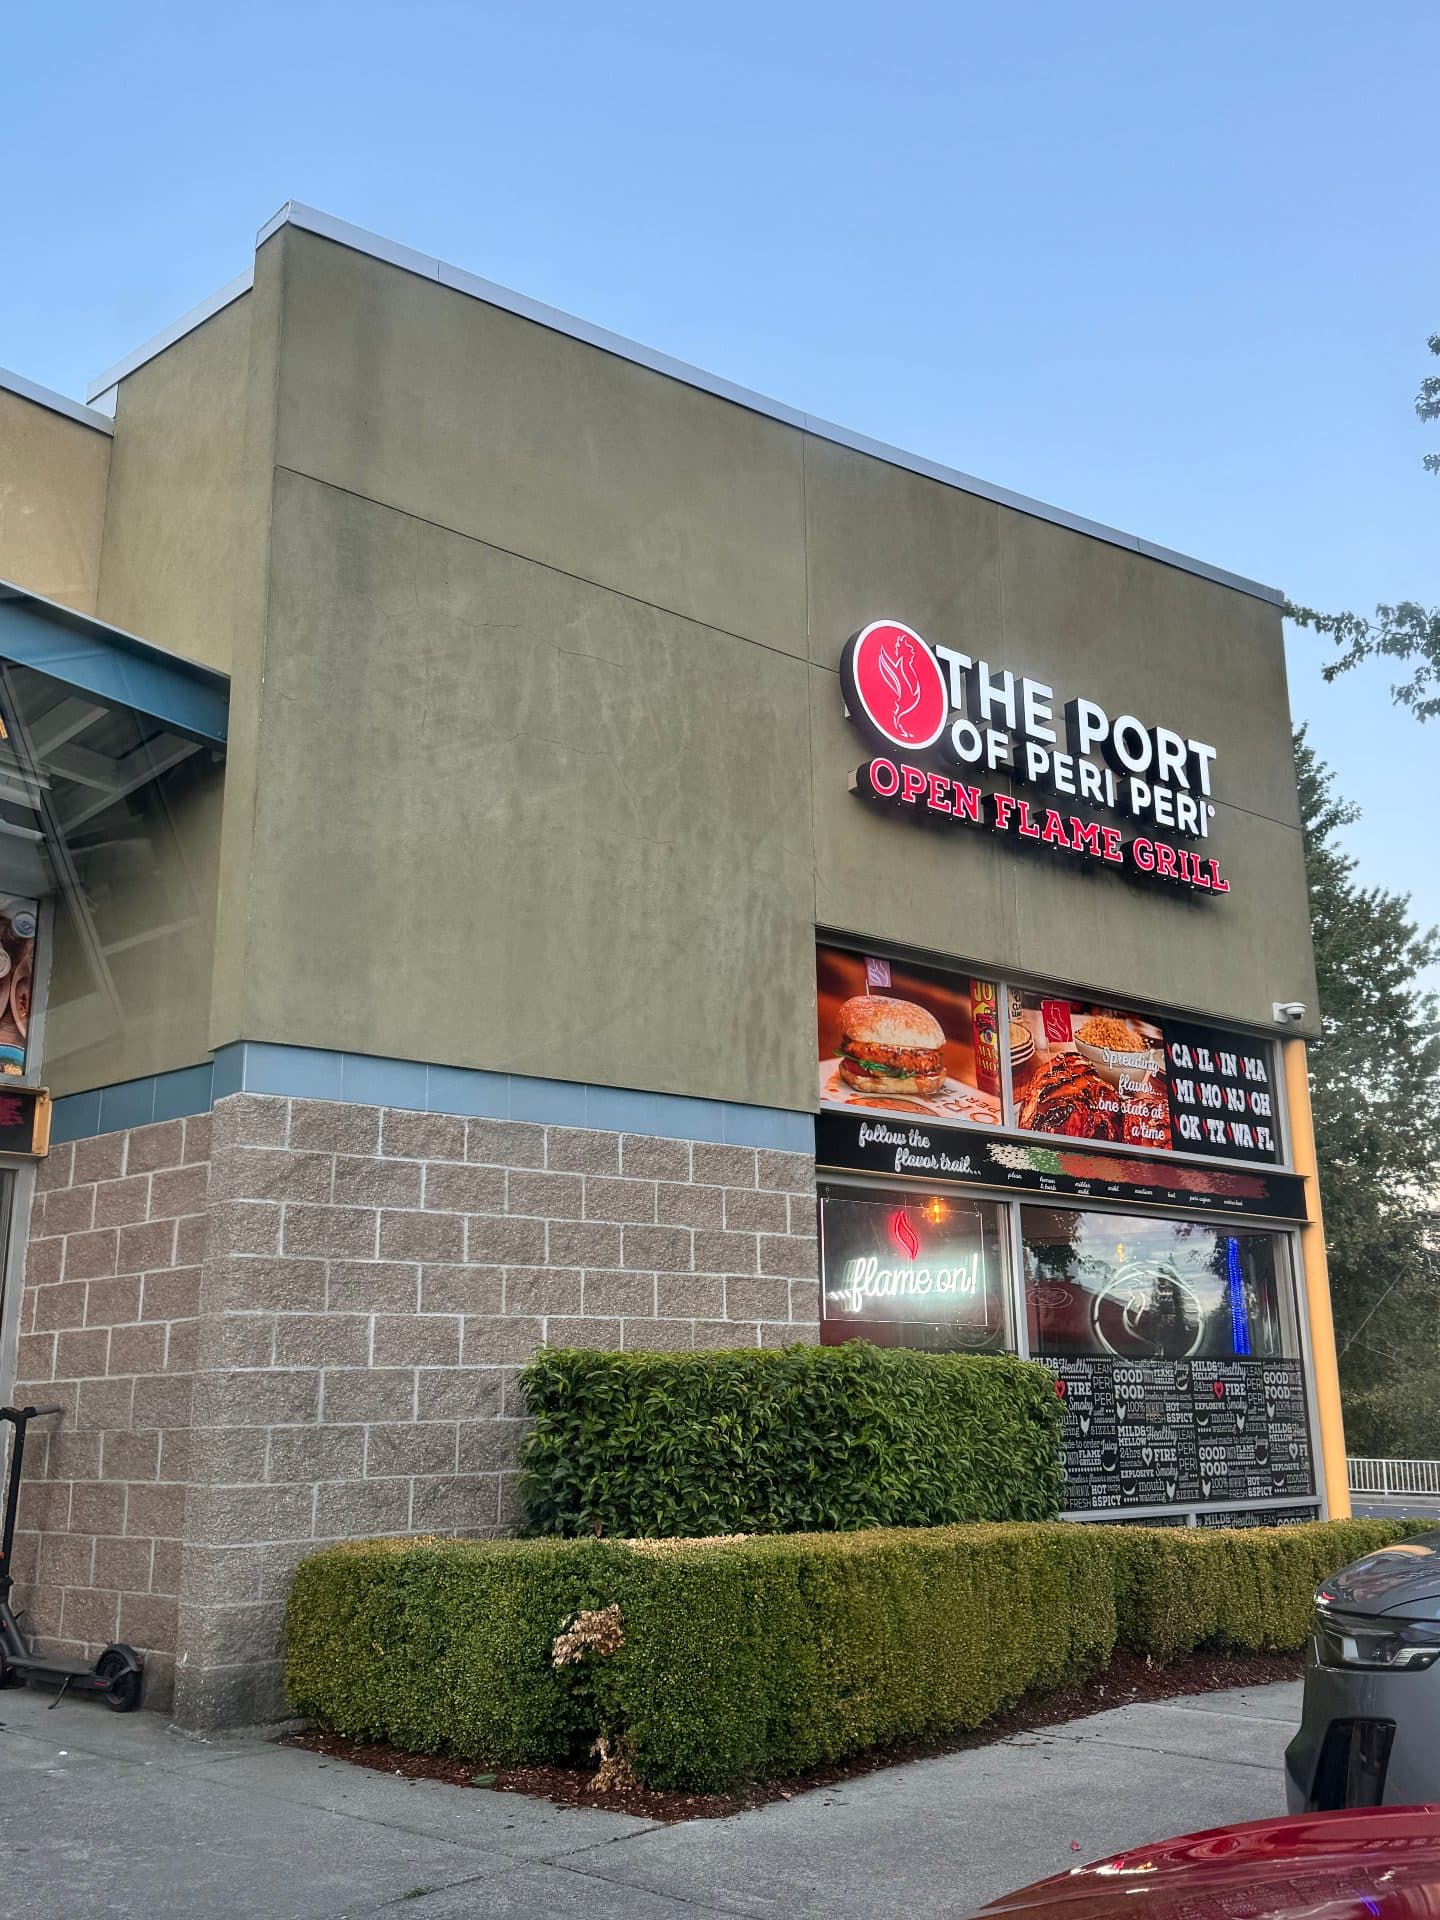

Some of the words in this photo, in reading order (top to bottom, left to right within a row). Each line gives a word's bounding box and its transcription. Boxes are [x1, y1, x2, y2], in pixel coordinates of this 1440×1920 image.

[934, 644, 1057, 745] THE
[1077, 697, 1218, 797] PORT
[951, 719, 1010, 771] OF
[1026, 743, 1116, 808] PERI
[869, 757, 982, 822] OPEN
[993, 792, 1124, 864] FLAME
[1132, 837, 1231, 893] GRILL
[1102, 1047, 1160, 1078] Spreading
[1172, 1041, 1194, 1070] CA
[1197, 1048, 1215, 1073] IL
[1220, 1053, 1238, 1078] IN
[1243, 1057, 1268, 1083] MA
[1176, 1078, 1196, 1103] MI
[1201, 1083, 1222, 1109] MO
[1225, 1087, 1245, 1113] NJ
[1251, 1093, 1272, 1117] OH
[1120, 1097, 1151, 1118] state
[1151, 1104, 1164, 1120] at
[858, 1121, 907, 1148] follow
[907, 1129, 931, 1148] the
[1131, 1125, 1140, 1137] a
[1140, 1121, 1166, 1141] time
[1179, 1115, 1201, 1141] OK
[1206, 1119, 1227, 1144] TX
[1231, 1122, 1254, 1149] WA
[1255, 1127, 1275, 1152] FL
[894, 1147, 940, 1173] flavor
[936, 1252, 979, 1295] on!
[1059, 1358, 1094, 1379] Healthy
[1217, 1361, 1247, 1381] Healthy
[1092, 1376, 1112, 1389] PERI
[1113, 1369, 1143, 1383] GOOD
[1263, 1371, 1288, 1384] GOOD
[1067, 1382, 1092, 1395] FIRE
[1114, 1385, 1144, 1399] FOOD
[1225, 1383, 1247, 1396] FIRE
[1264, 1386, 1290, 1399] FOOD
[1069, 1396, 1094, 1416] Smoky
[1094, 1392, 1114, 1406] PERI
[1165, 1402, 1180, 1411] HOT
[1166, 1412, 1193, 1422] &SPICY
[1117, 1425, 1146, 1437] MILD&
[1146, 1425, 1178, 1446] Healthy
[1118, 1438, 1146, 1447] MELLOW
[1078, 1449, 1101, 1459] FLAME
[1120, 1447, 1141, 1458] 24hrs
[1153, 1448, 1177, 1461] FIRE
[1199, 1446, 1226, 1460] GOOD
[1120, 1469, 1154, 1478] EXPLOSIVE
[1200, 1462, 1227, 1476] FOOD
[1139, 1479, 1165, 1491] mouth
[1246, 1476, 1261, 1486] HOT
[1091, 1484, 1107, 1495] HOT
[1247, 1486, 1273, 1497] &SPICY
[1092, 1495, 1121, 1507] &SPICY
